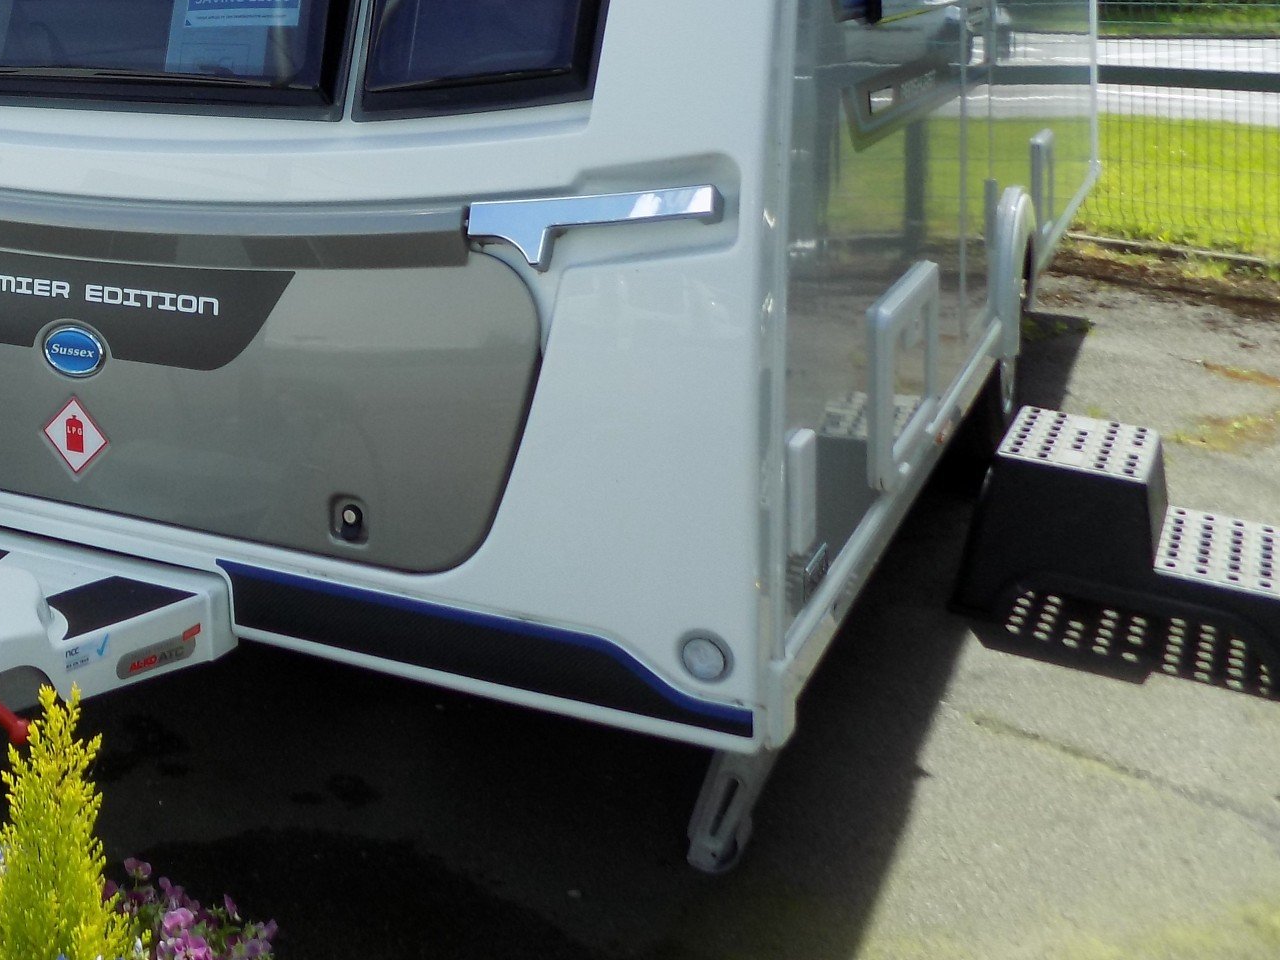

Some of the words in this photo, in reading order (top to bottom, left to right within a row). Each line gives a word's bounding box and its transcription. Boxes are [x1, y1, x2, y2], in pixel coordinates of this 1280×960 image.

[84, 284, 220, 316] EDITION
[51, 343, 95, 359] Sussex
[67, 425, 83, 436] LPG
